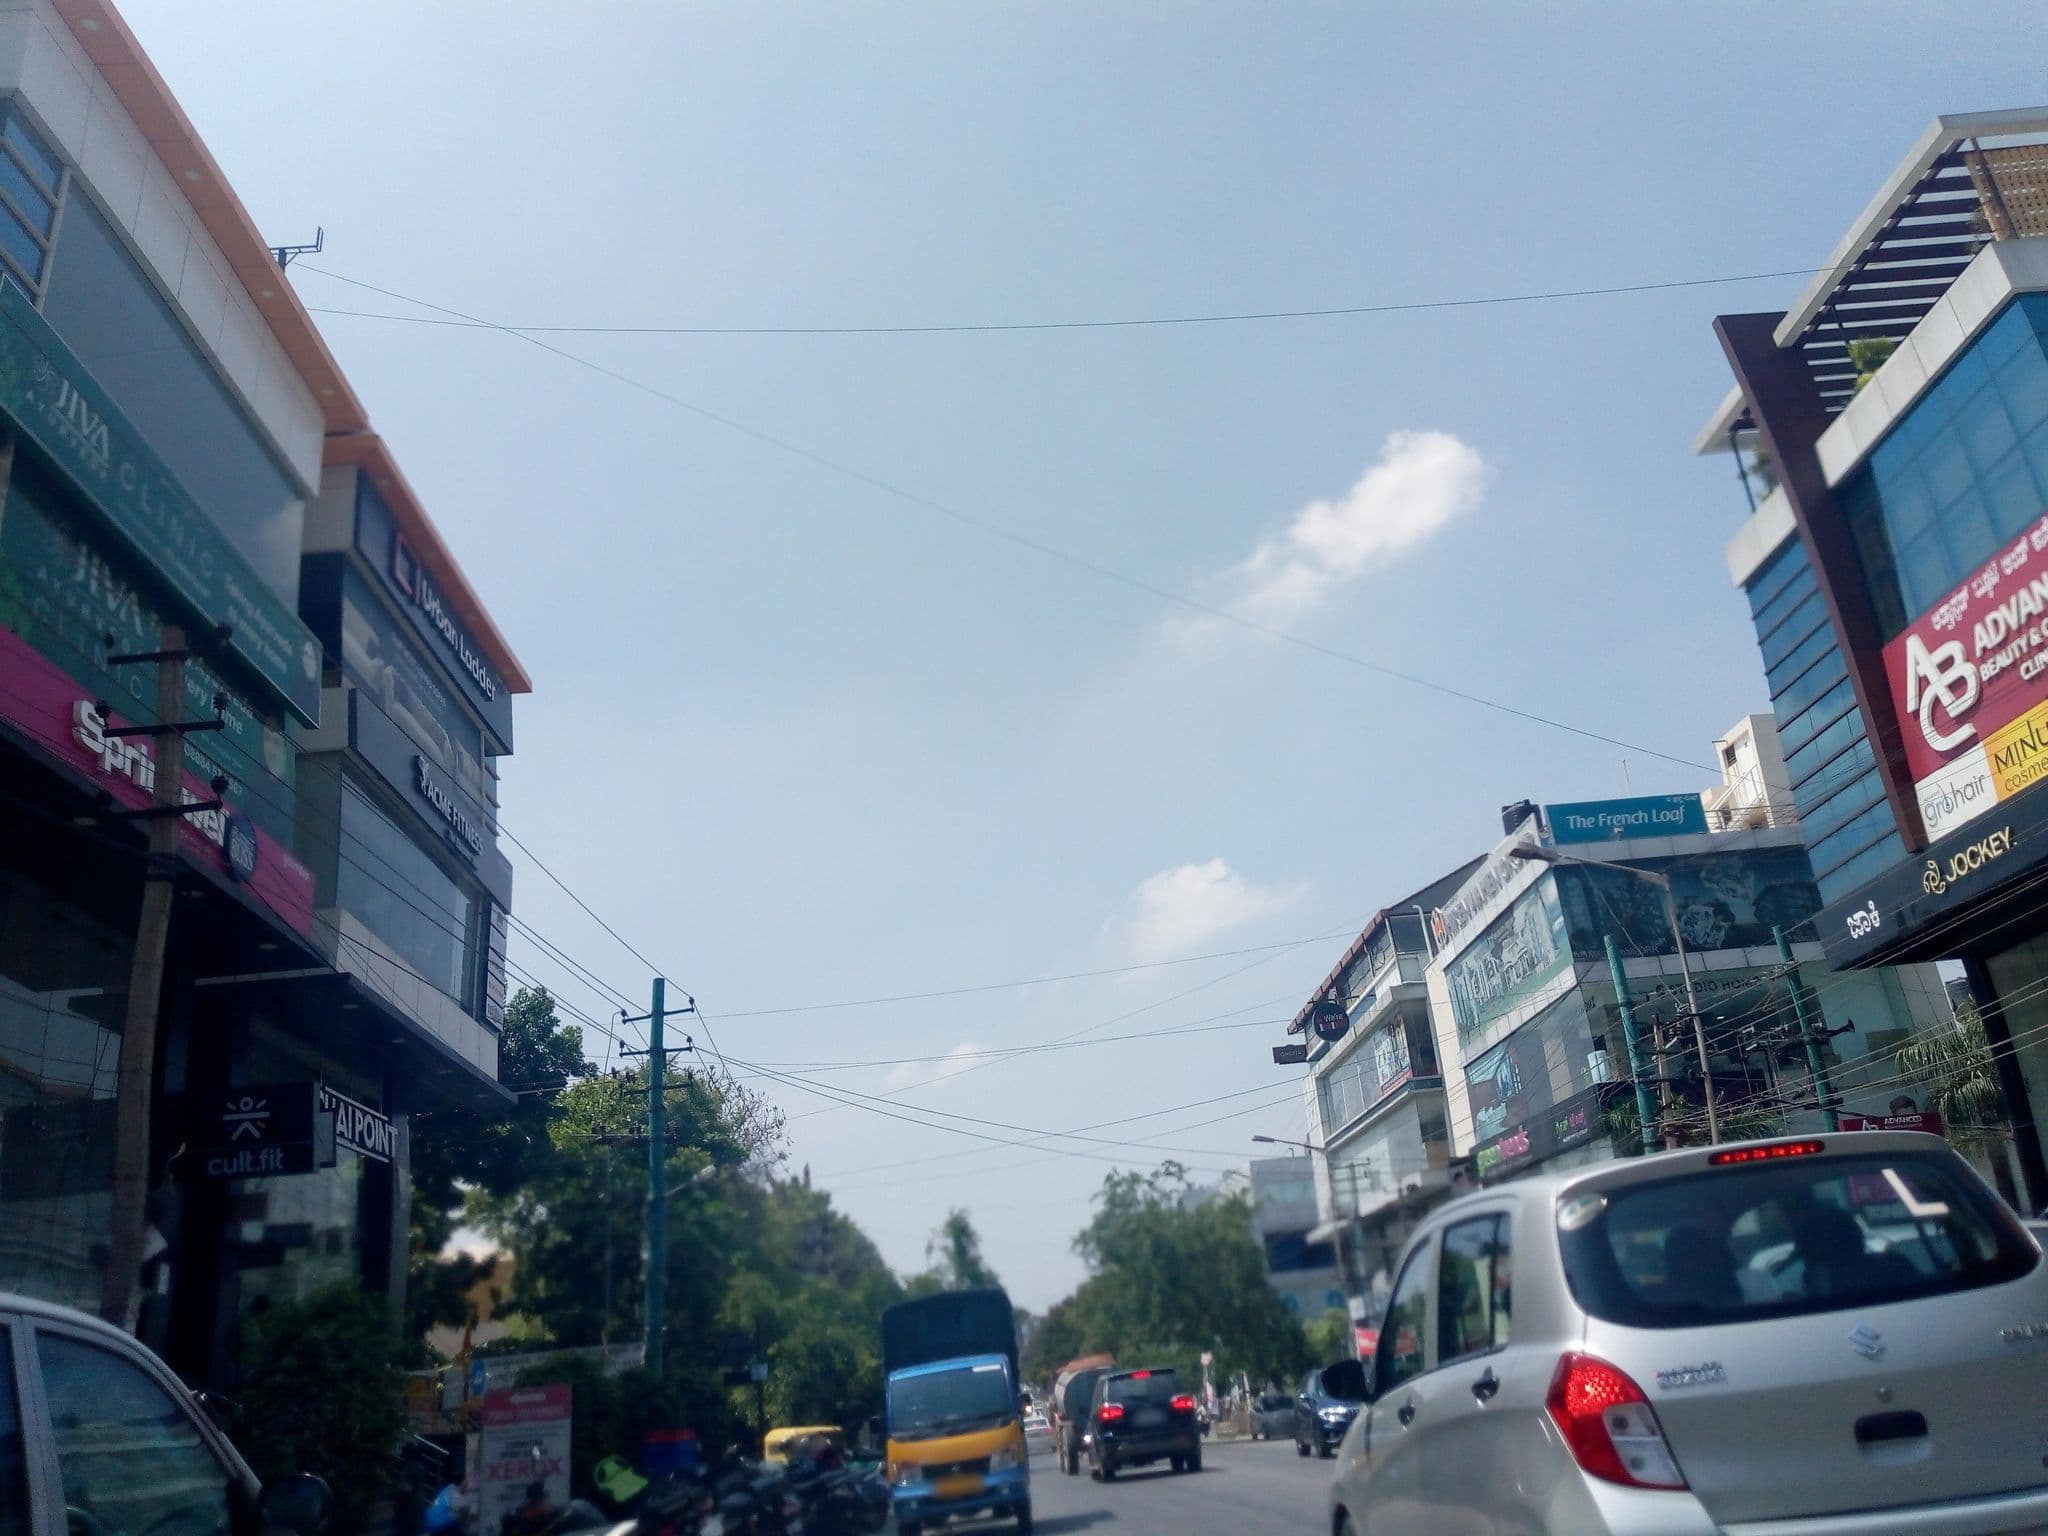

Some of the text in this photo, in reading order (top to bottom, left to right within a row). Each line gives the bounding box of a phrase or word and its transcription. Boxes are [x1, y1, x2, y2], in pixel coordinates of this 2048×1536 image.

[421, 579, 458, 650] Urban
[459, 637, 496, 701] Ladder
[1980, 633, 2028, 682] BEAUTY
[427, 777, 451, 822] ACME
[452, 805, 483, 857] FITNESS
[1566, 805, 1685, 829] The French Loaf
[355, 1108, 398, 1157] POINT
